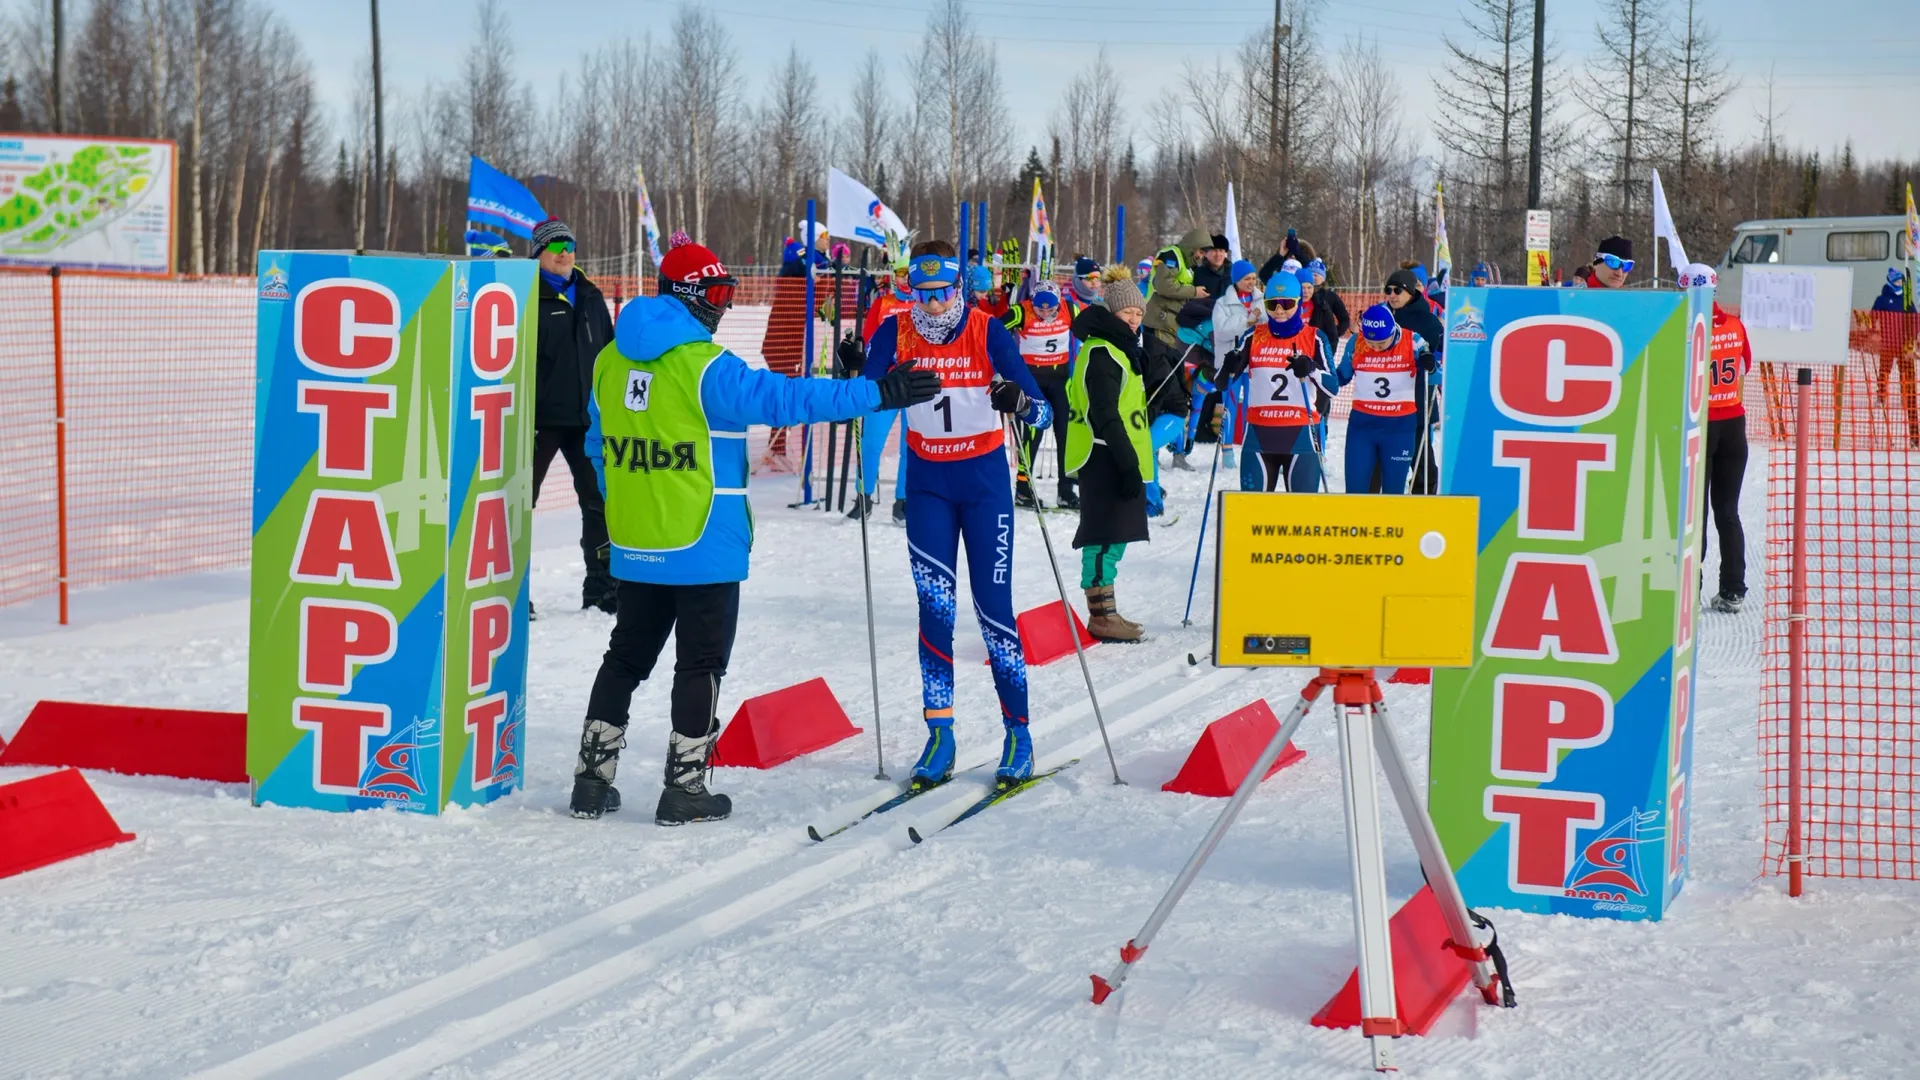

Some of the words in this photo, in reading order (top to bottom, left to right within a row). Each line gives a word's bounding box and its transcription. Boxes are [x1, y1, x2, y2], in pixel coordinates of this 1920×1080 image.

[1045, 338, 1058, 353] 5
[949, 371, 983, 380] ЛЫЖНЯ
[1710, 357, 1736, 387] 15
[1270, 373, 1289, 401] 2
[1374, 376, 1391, 398] 3
[934, 395, 953, 433] 1
[921, 440, 976, 454] САЛЕХАРД
[290, 277, 401, 796] СТАРТ
[464, 282, 518, 792] СТАРТ
[1251, 525, 1404, 538] WWW.MARATHON-E.RU
[624, 553, 665, 563] NORDSKI
[993, 513, 1010, 584] ЯМАЛ
[1251, 553, 1404, 566] МАРАФОН-ЭЛЕКТРО
[1481, 314, 1623, 897] СТАРТ
[1668, 313, 1706, 885] СТАРТ
